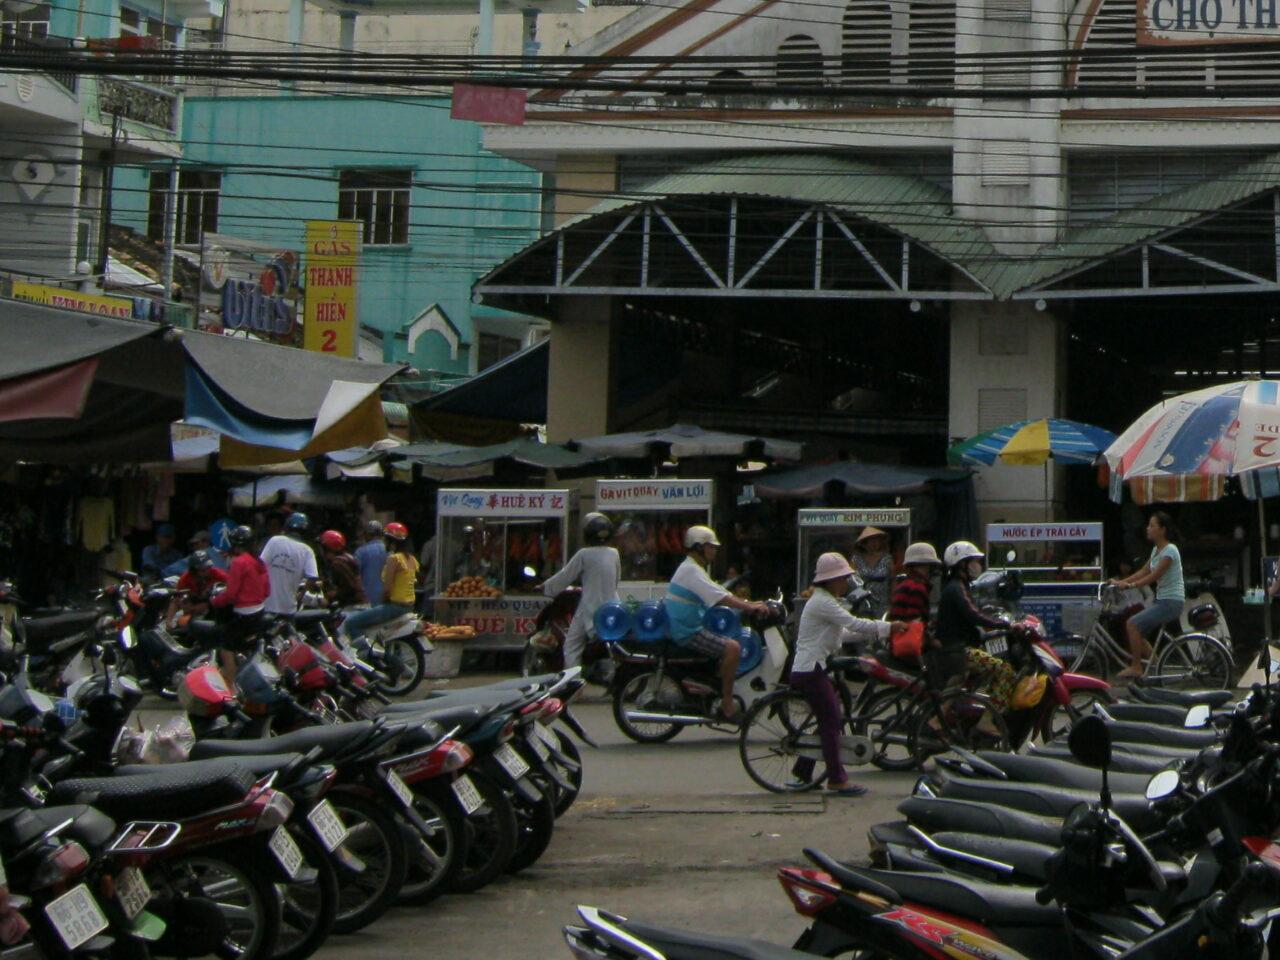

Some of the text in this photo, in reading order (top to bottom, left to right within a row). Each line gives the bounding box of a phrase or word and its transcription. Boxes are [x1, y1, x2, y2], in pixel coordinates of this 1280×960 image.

[310, 267, 354, 287] THANH
[321, 329, 337, 352] 2
[1252, 436, 1279, 458] 2
